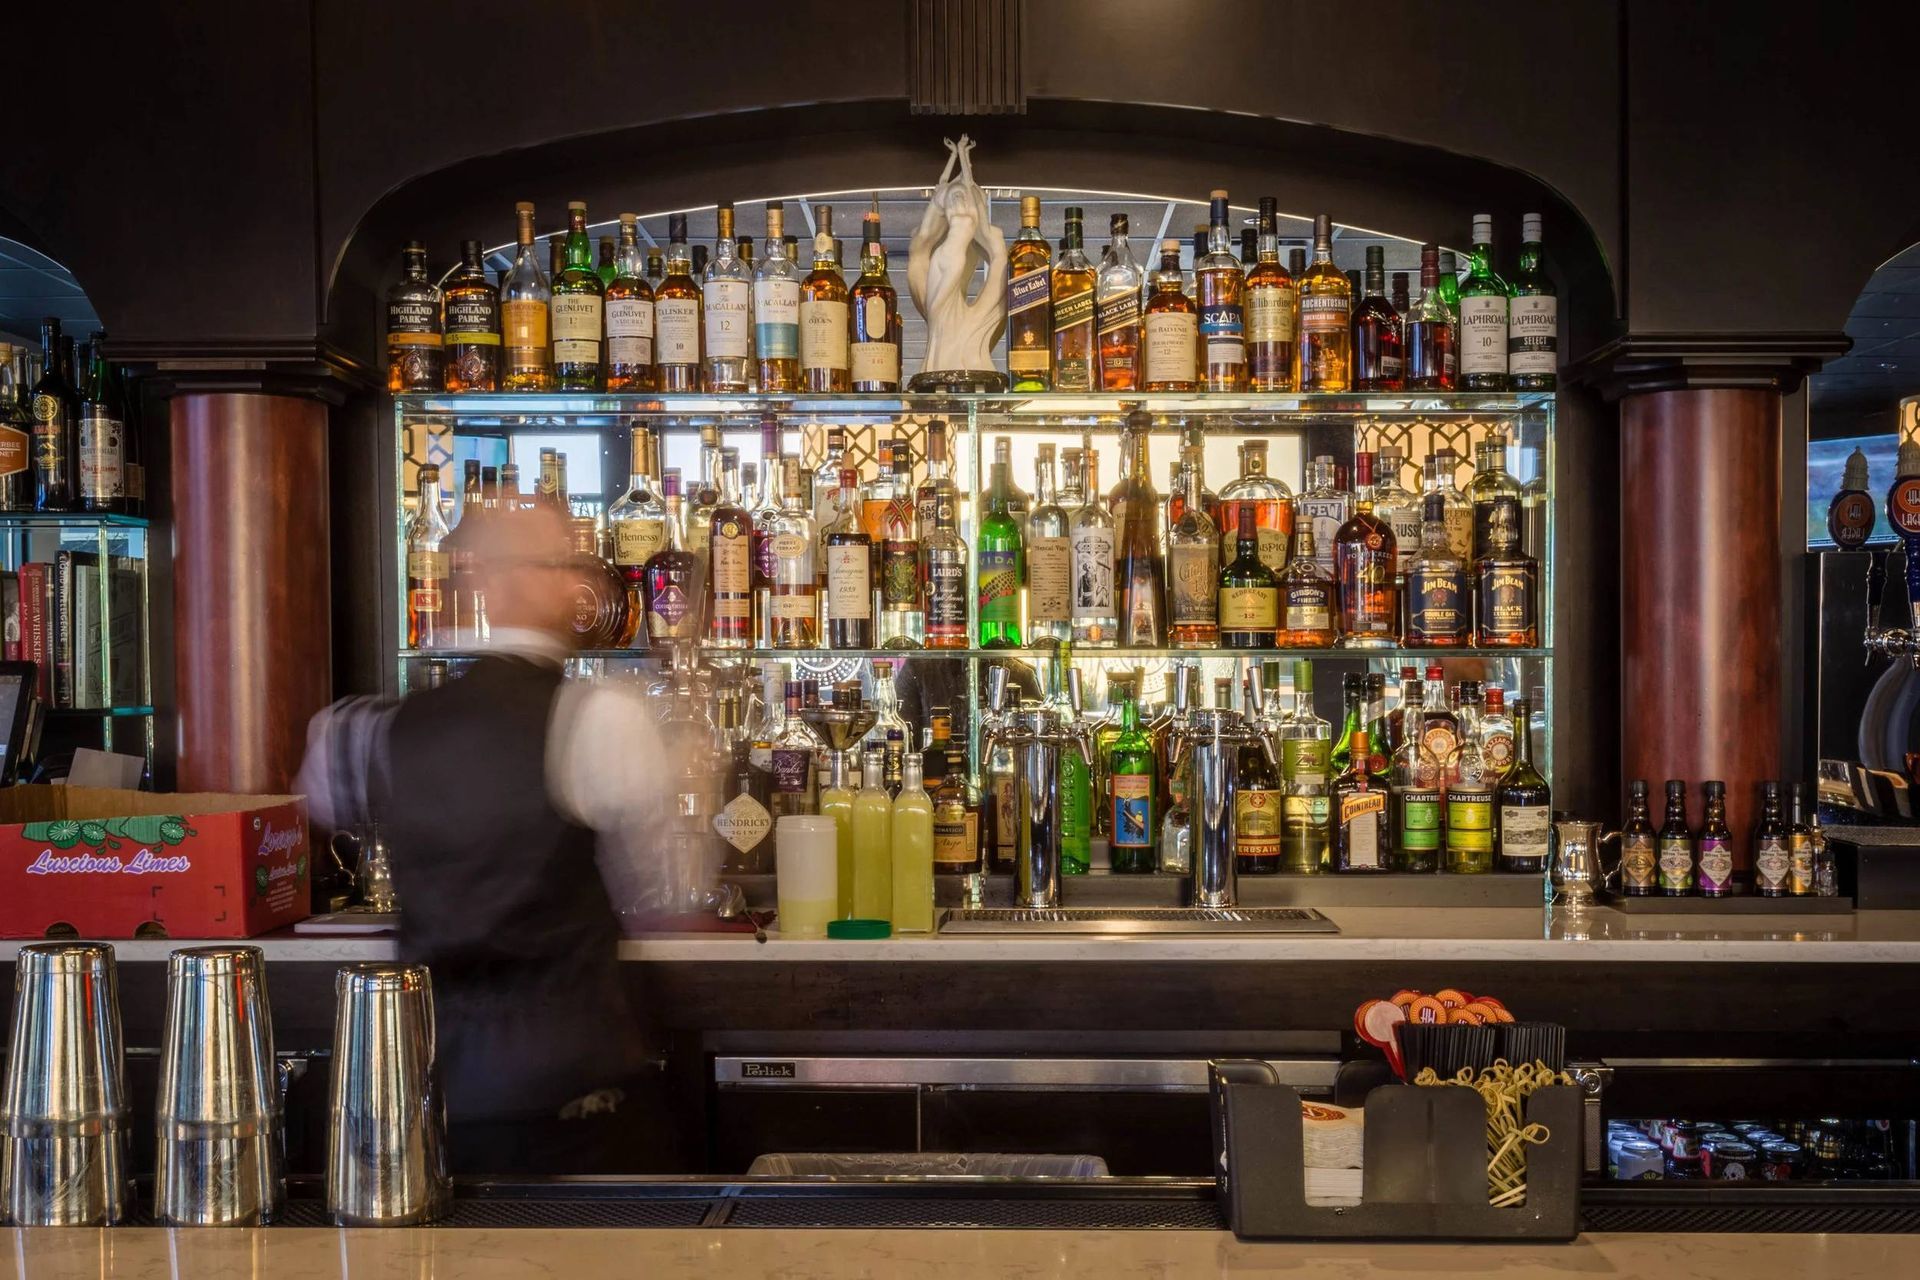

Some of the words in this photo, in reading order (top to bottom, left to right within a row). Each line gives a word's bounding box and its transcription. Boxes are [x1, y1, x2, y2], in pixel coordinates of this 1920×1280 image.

[1013, 284, 1029, 298] Blue
[1027, 277, 1046, 291] Label
[555, 304, 594, 314] GLENLIVET
[706, 303, 747, 312] MACALLAN
[1074, 298, 1093, 310] LABEL
[1098, 307, 1118, 319] BLACK
[1119, 299, 1139, 310] LABEL
[390, 306, 433, 315] HIGHLAND
[448, 306, 492, 315] HIGHLAND
[611, 311, 647, 319] GLENLIVET
[658, 308, 695, 316] TALISKER
[399, 315, 421, 324] PARK
[457, 315, 480, 323] PARK
[1204, 310, 1241, 324] SCAPA
[720, 320, 732, 331] 12
[1482, 337, 1492, 347] 10
[1523, 336, 1547, 345] SELECT
[675, 342, 684, 350] 10
[1307, 503, 1340, 518] FEW
[621, 532, 660, 542] Hennessy
[979, 556, 1014, 566] VIDA
[933, 568, 963, 578] LAIRD'S
[1422, 580, 1437, 594] JIM
[1437, 578, 1458, 594] BEAM
[1491, 578, 1505, 590] JIM
[1505, 575, 1524, 590] BEAM
[1290, 589, 1325, 598] GIBSON'S
[32, 614, 41, 663] WHISKIES
[1344, 799, 1381, 818] COINTREAU
[717, 819, 769, 827] HENDRICK'S
[27, 849, 122, 873] Luscious
[122, 849, 191, 873] Limes
[745, 1064, 792, 1076] Perlick
